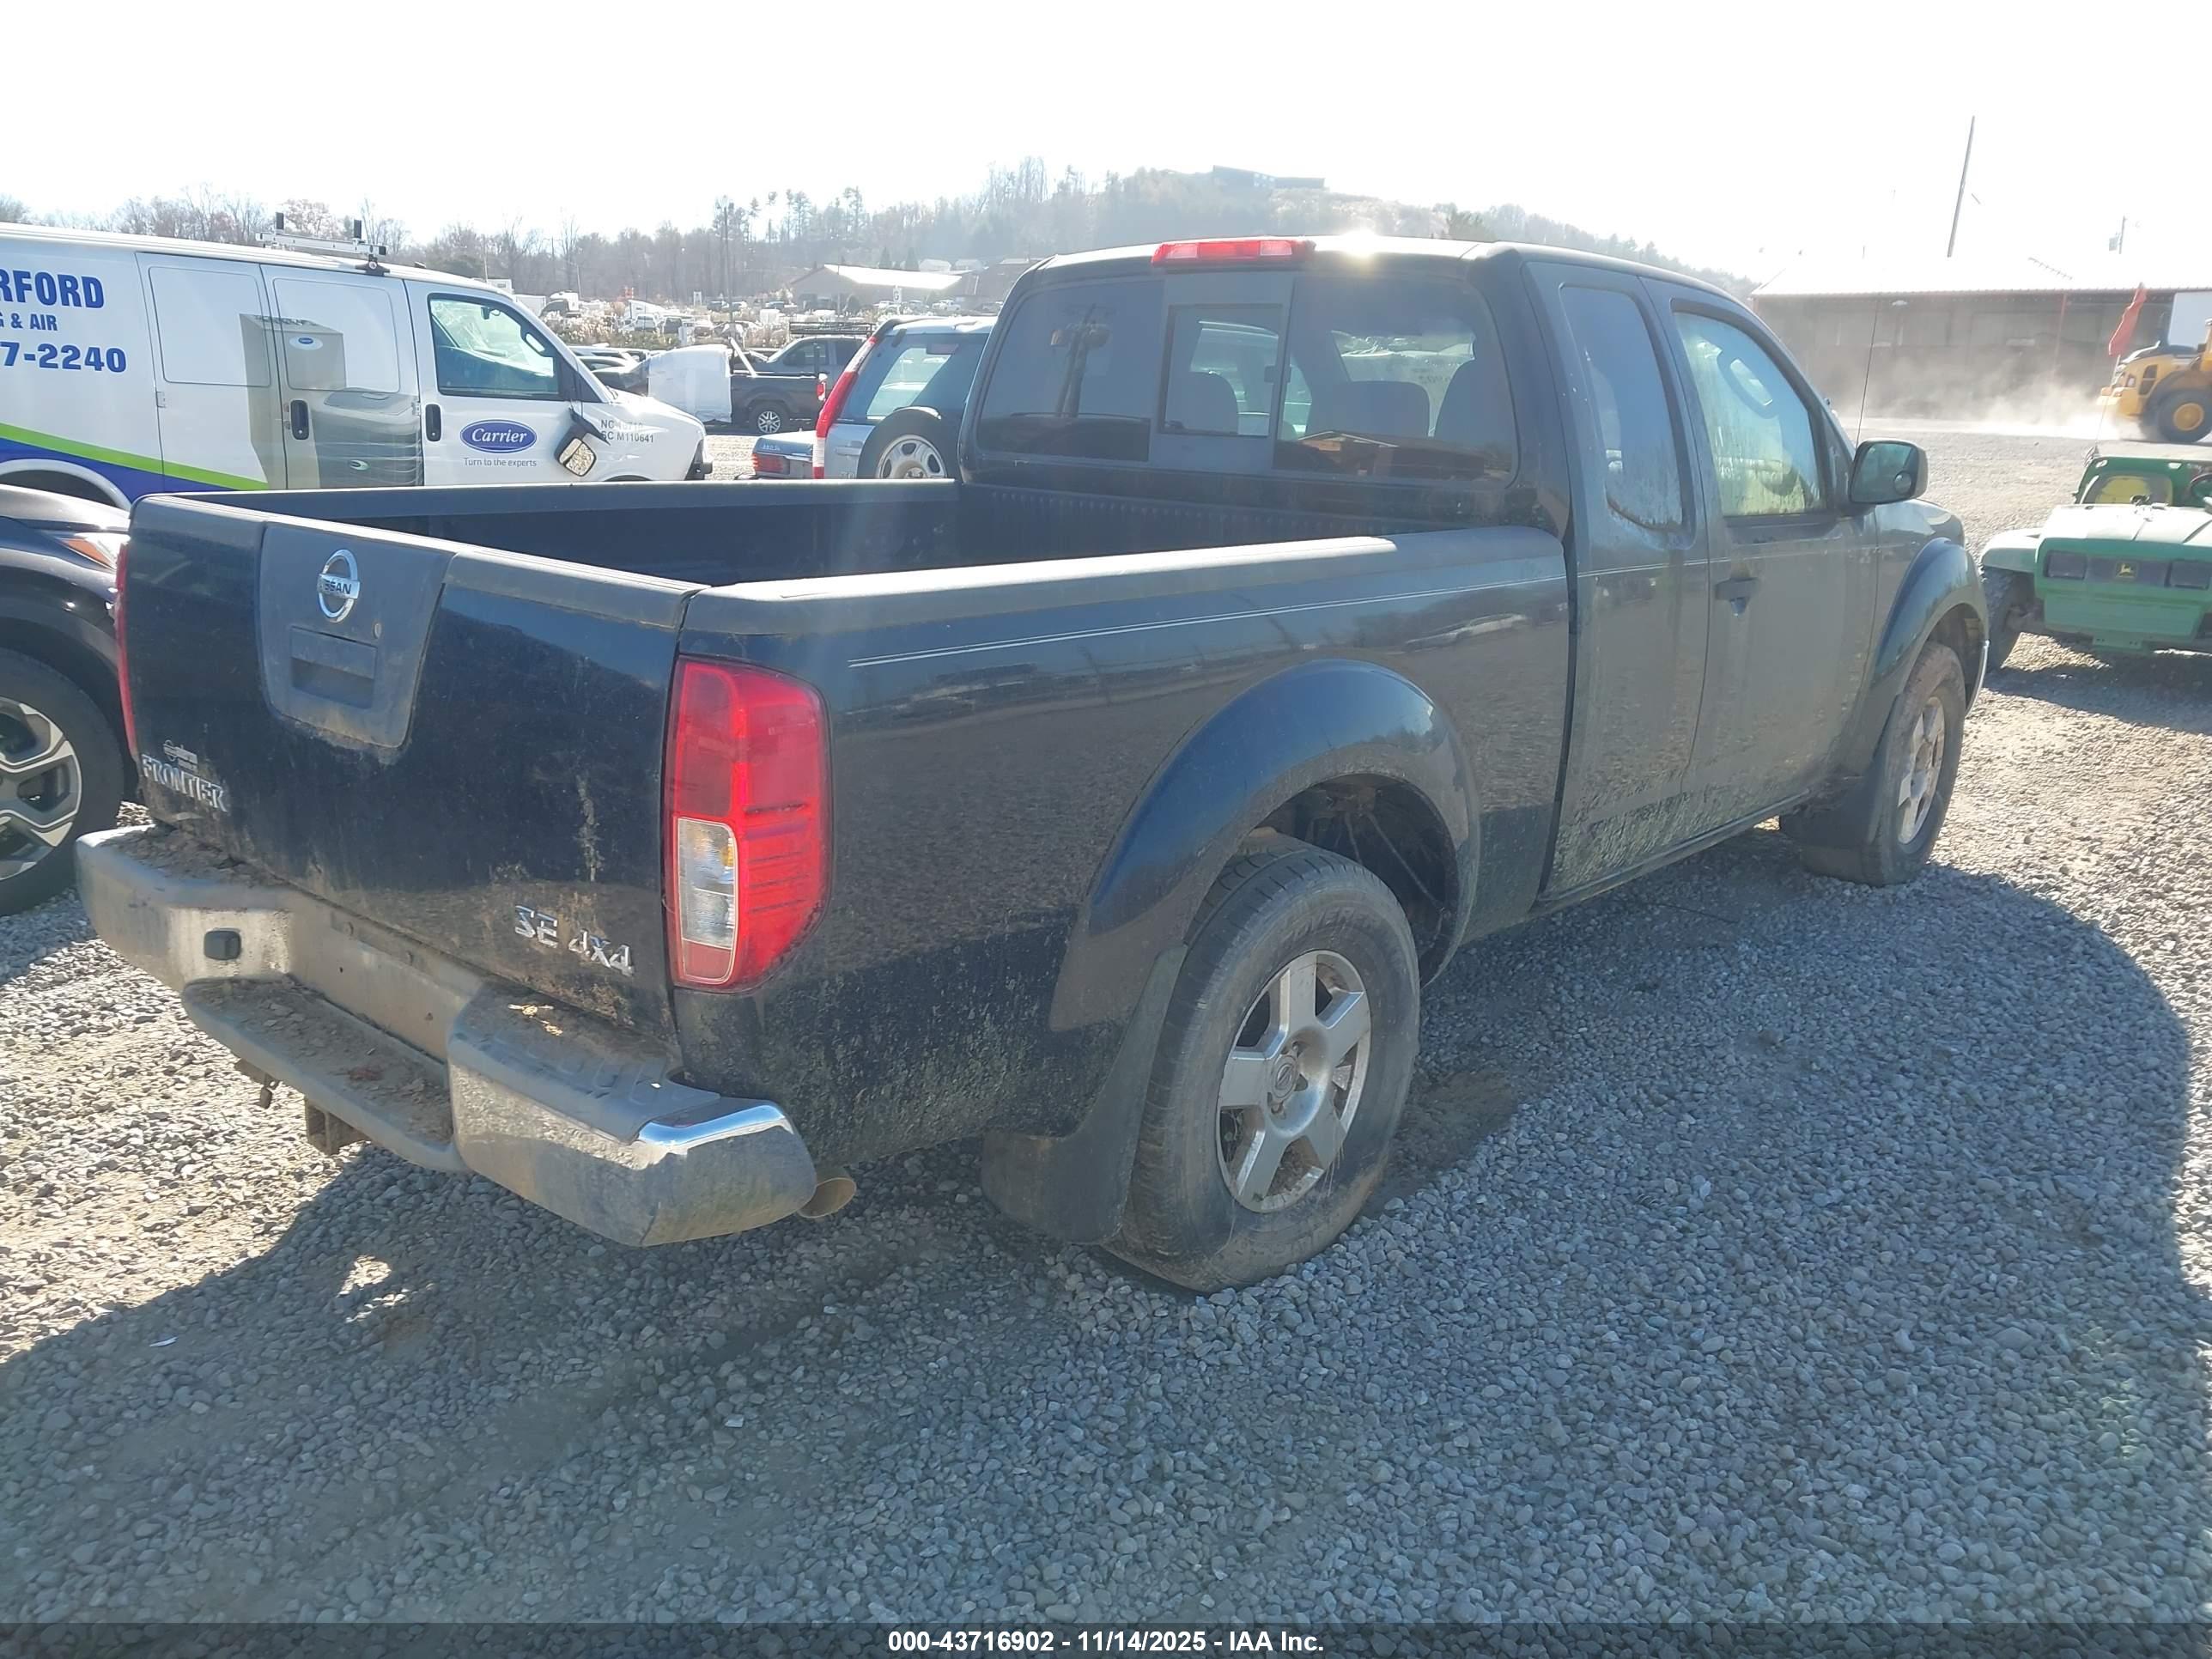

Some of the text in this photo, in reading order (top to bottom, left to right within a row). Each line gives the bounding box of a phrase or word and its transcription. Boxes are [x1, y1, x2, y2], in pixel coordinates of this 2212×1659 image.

[11, 313, 23, 328] &
[30, 313, 58, 331] AIR
[0, 341, 126, 373] 7-2240
[471, 428, 527, 443] Carrier
[617, 432, 653, 442] M110641
[464, 457, 537, 468] Turn to the experts
[141, 754, 228, 812] FRONTIER
[515, 905, 558, 948] SE
